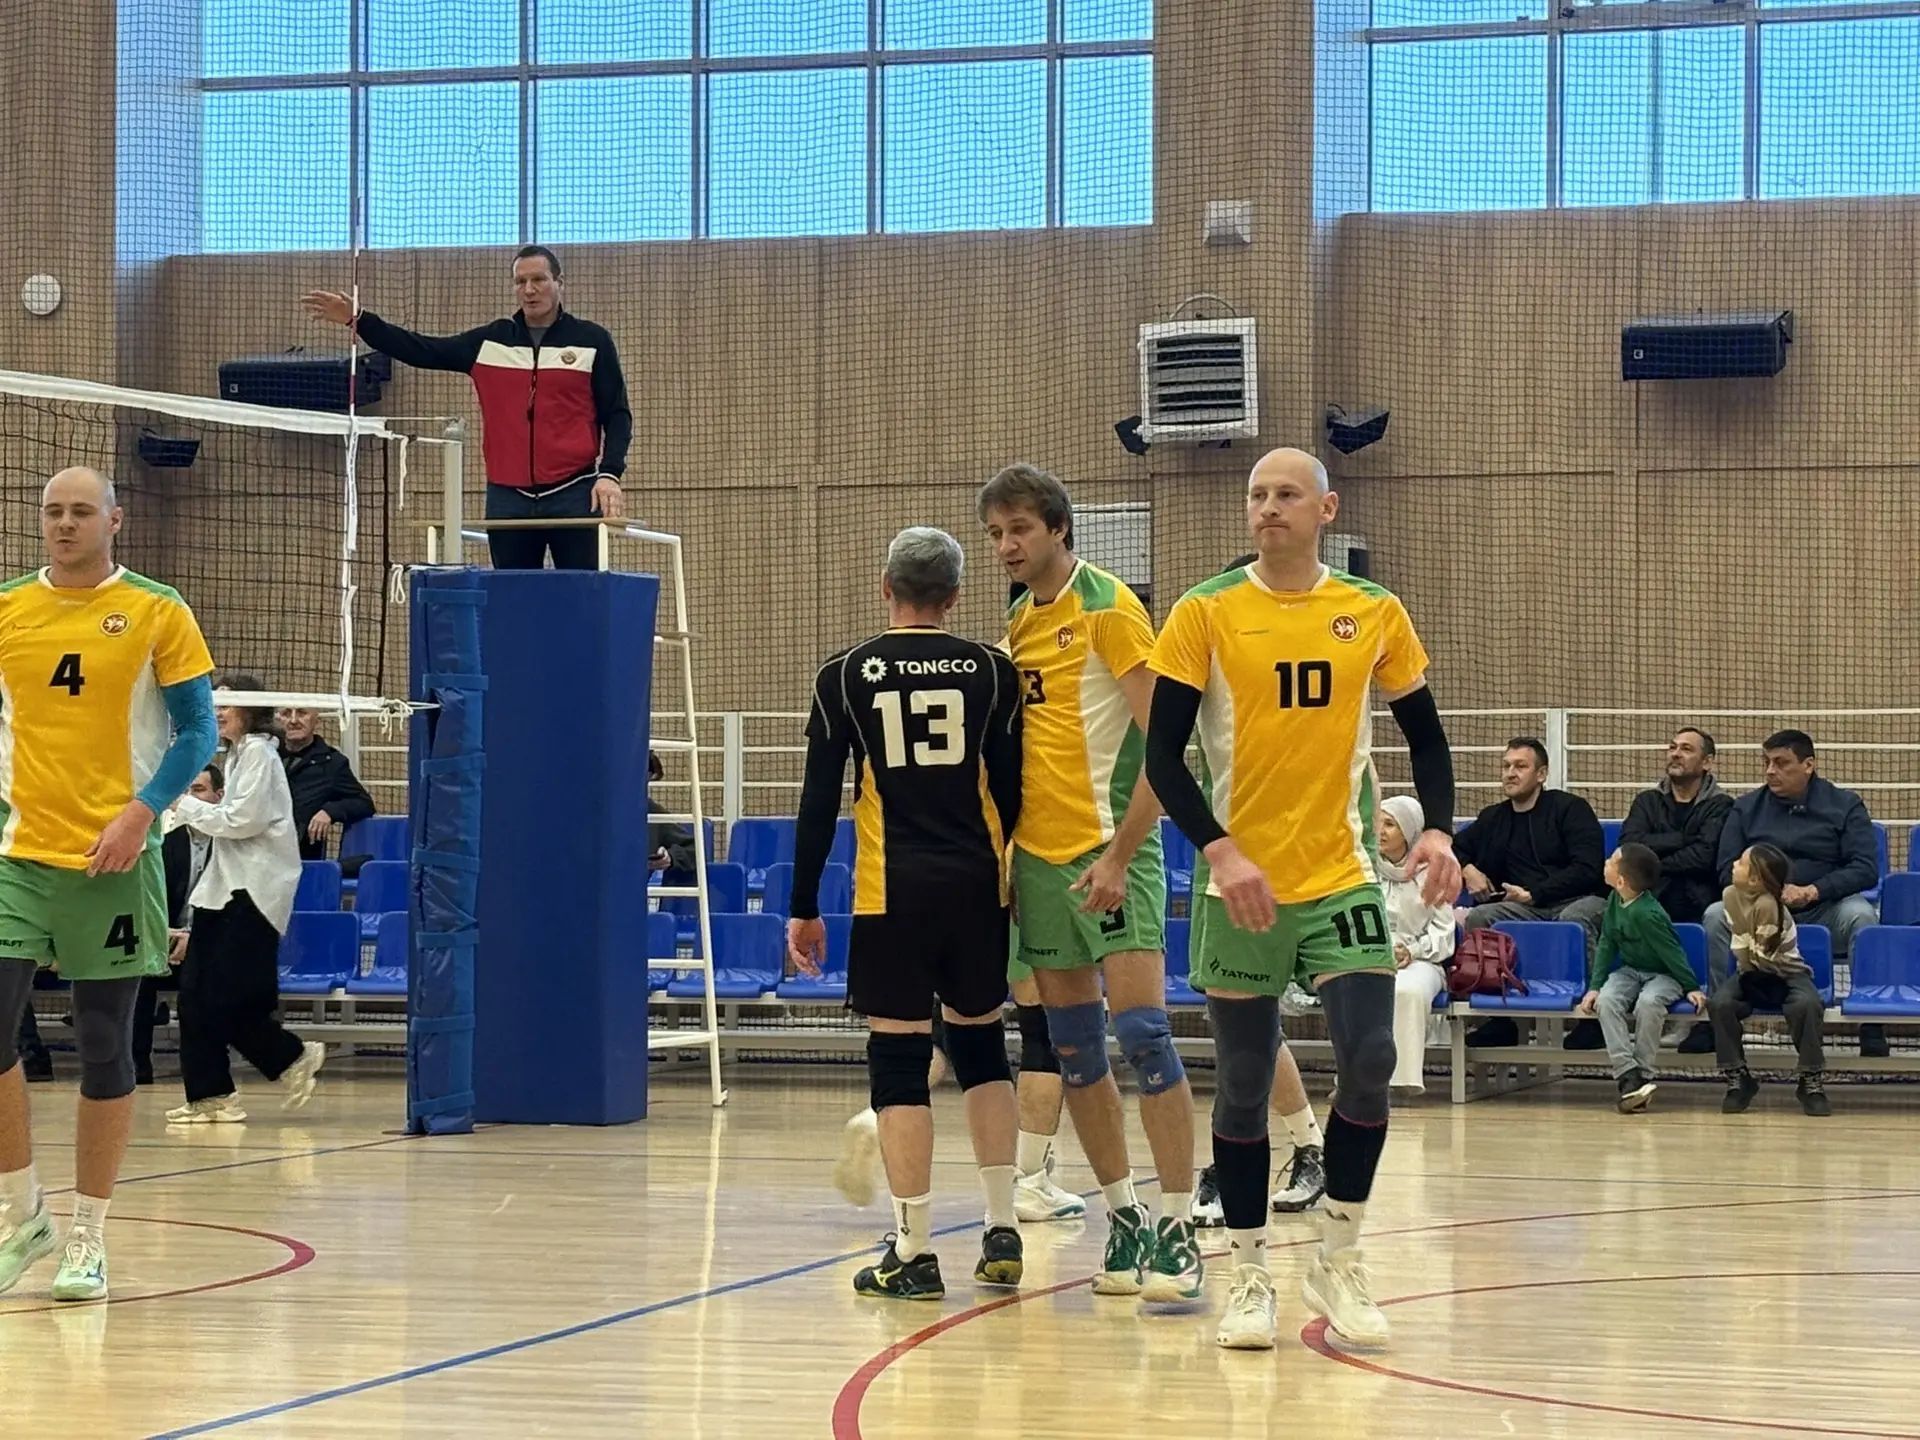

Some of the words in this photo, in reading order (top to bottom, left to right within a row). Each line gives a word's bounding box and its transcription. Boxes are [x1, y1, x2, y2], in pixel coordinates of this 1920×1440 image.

[49, 653, 85, 696] 4
[894, 659, 978, 675] TANECO
[1274, 661, 1332, 708] 10
[872, 689, 966, 768] 13
[104, 913, 140, 956] 4
[1331, 903, 1387, 948] 10
